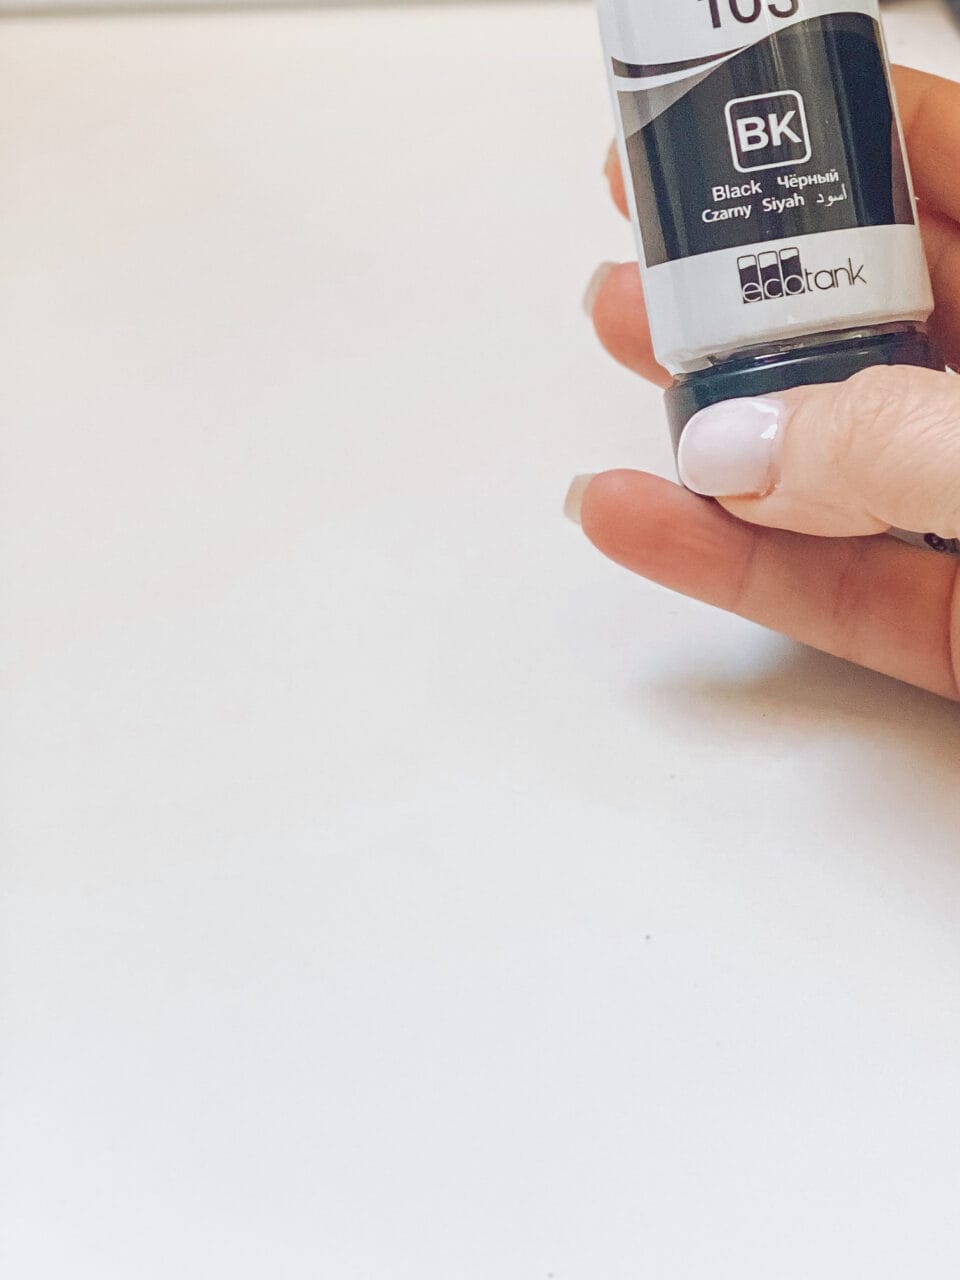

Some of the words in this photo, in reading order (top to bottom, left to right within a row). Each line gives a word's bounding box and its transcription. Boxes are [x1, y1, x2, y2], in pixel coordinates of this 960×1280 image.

[736, 110, 802, 153] BK
[711, 180, 762, 202] Black
[776, 168, 840, 190] Чёрный
[701, 204, 752, 223] Czarny
[761, 192, 805, 213] Siyah
[740, 257, 867, 305] ecotank
